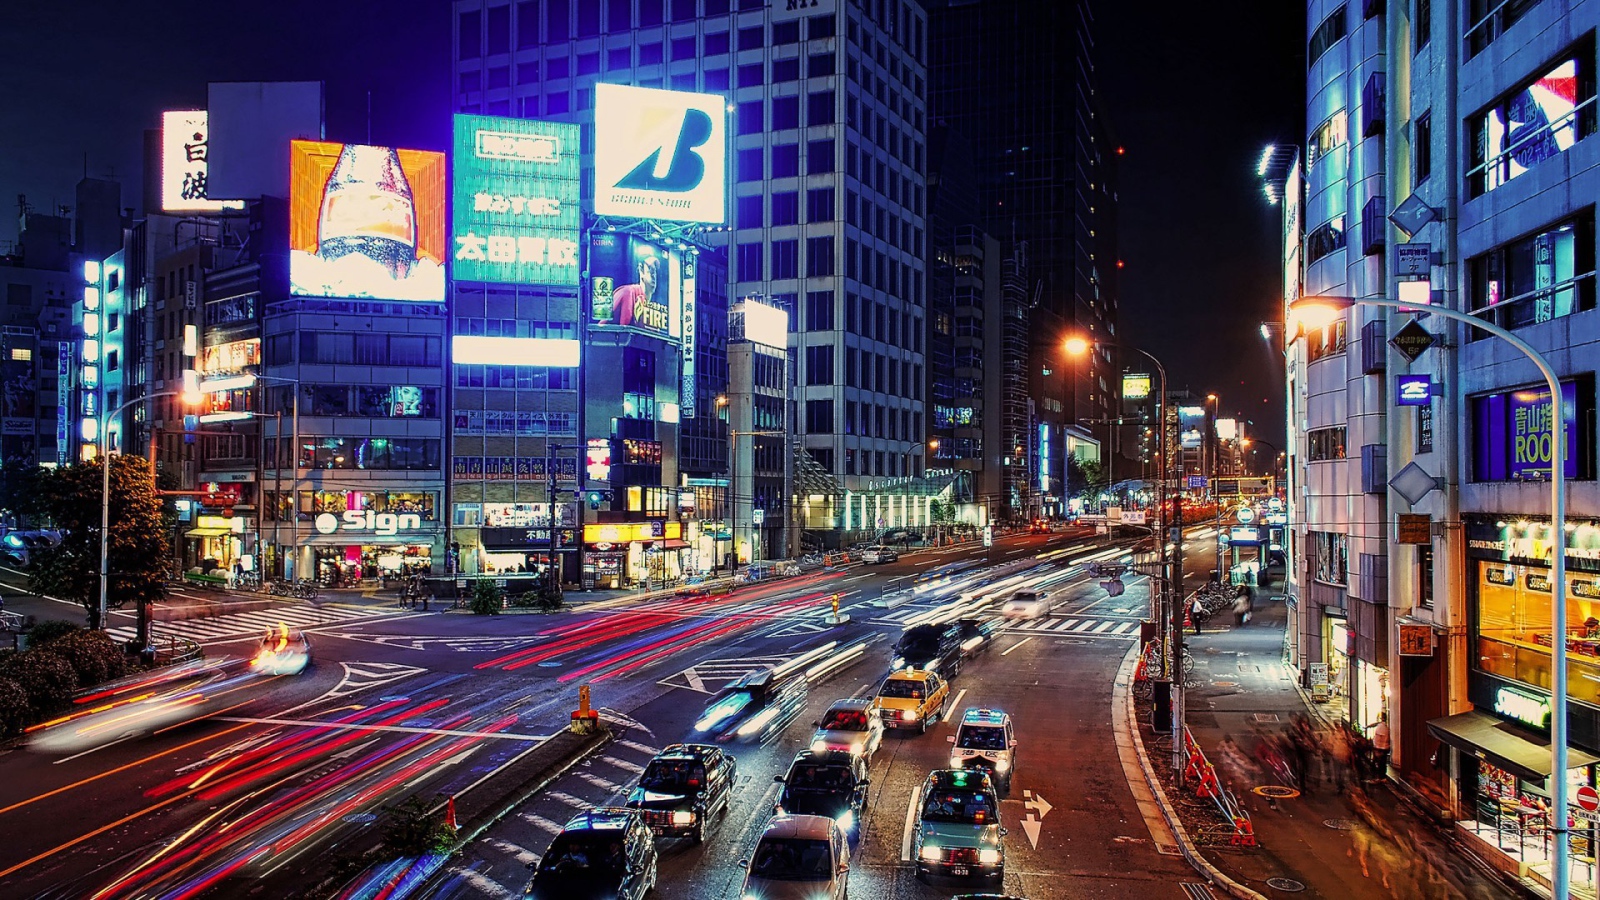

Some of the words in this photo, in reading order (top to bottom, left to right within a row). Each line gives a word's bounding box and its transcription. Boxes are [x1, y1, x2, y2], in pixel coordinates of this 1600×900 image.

[643, 306, 668, 330] FIRE
[1515, 432, 1568, 463] ROO
[342, 509, 421, 535] Sign
